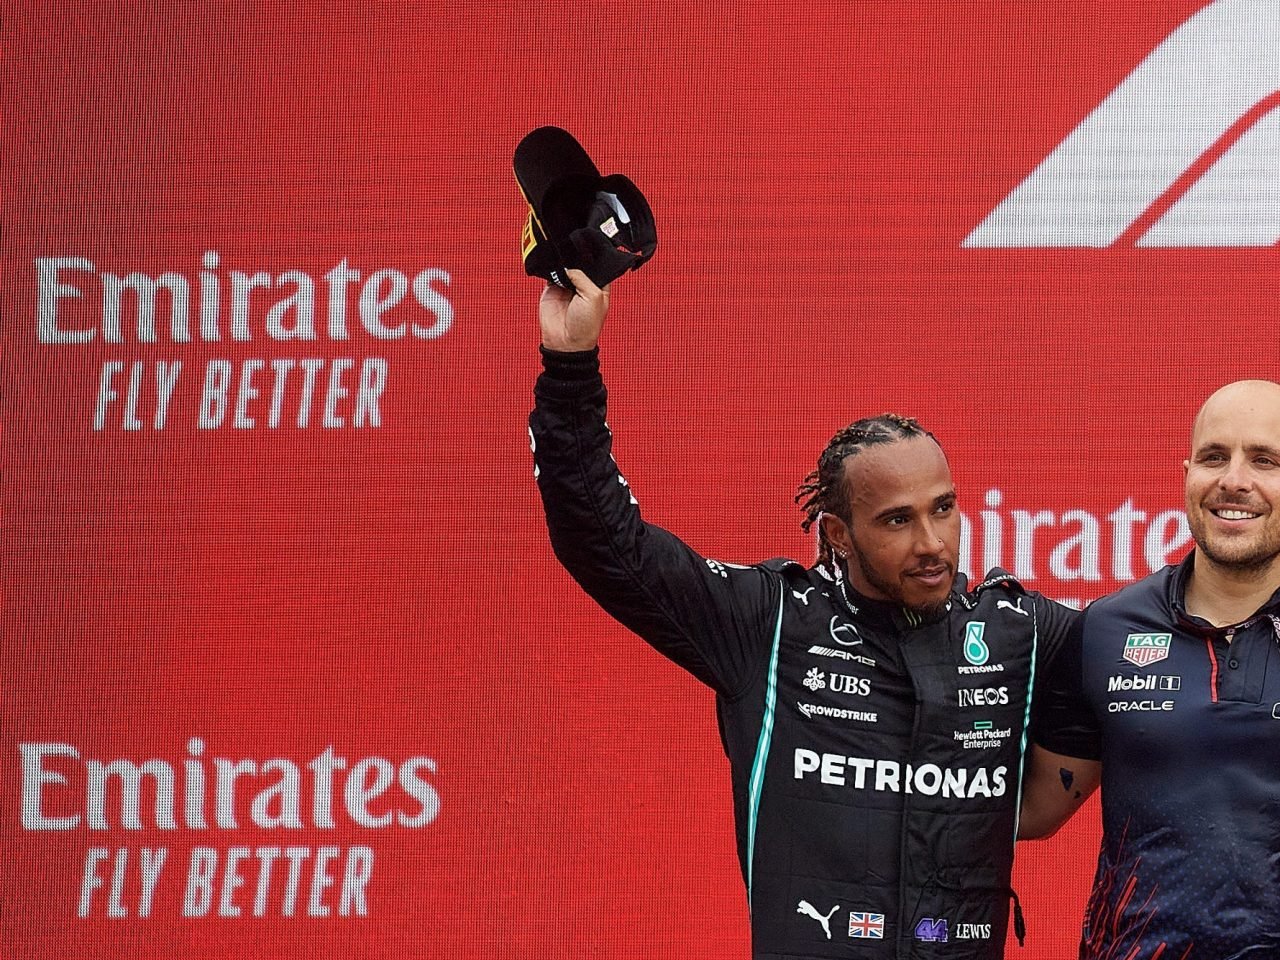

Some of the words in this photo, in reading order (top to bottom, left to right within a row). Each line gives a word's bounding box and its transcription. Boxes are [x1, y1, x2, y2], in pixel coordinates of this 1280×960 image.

[34, 250, 455, 345] Emirates
[93, 358, 183, 432] FLY
[197, 357, 389, 430] BETTER
[959, 488, 1195, 581] irate
[1129, 635, 1167, 647] TAG
[831, 649, 876, 667] AMG
[1125, 647, 1168, 665] HEUER
[958, 664, 1005, 675] PETRONAS
[829, 673, 872, 697] UBS
[1107, 675, 1156, 692] Mobil
[958, 687, 1009, 707] INEOS
[1108, 700, 1174, 712] ORACLE
[802, 703, 878, 723] CROWDSTRIKE
[954, 729, 983, 741] Hewlett
[983, 728, 1011, 739] Packard
[963, 738, 1002, 750] Enterprise
[793, 748, 1008, 799] PETRONAS
[18, 737, 442, 832] Emirates
[76, 845, 167, 919] FLY
[181, 844, 375, 918] BETTER
[914, 917, 949, 943] 44
[956, 923, 992, 940] LEWIS
